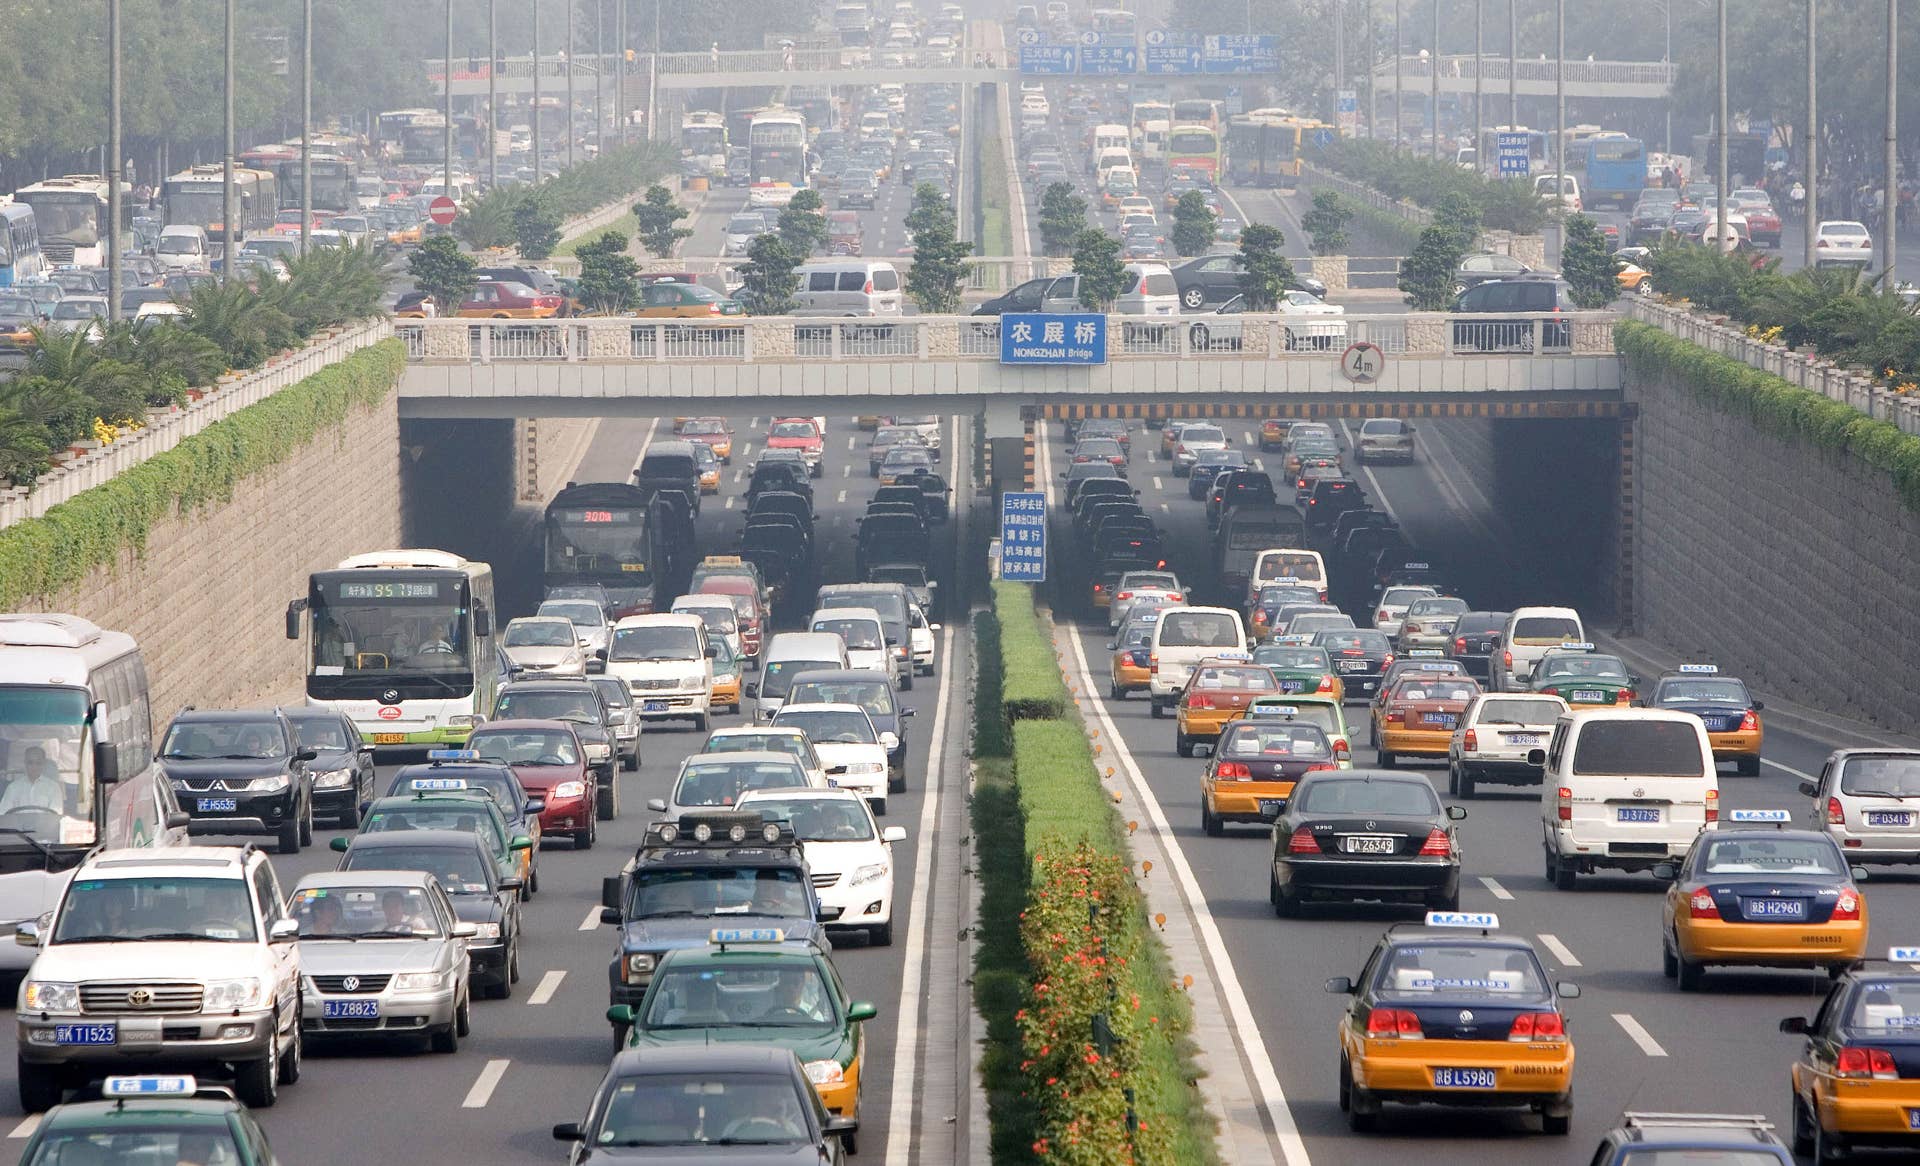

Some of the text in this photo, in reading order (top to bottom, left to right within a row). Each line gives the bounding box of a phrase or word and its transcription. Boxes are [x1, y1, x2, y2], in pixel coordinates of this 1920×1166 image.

[1010, 321, 1097, 345] 农展桥
[1013, 347, 1093, 360] NONGZHAN Bridge
[1353, 353, 1373, 372] 4m
[1005, 498, 1044, 510] 三元桥去往
[1005, 545, 1042, 557] 机场高速
[1003, 561, 1041, 574] 京承高速
[324, 1001, 377, 1016] 京JZ8823
[57, 1025, 114, 1042] 京KT1523
[1436, 1068, 1495, 1087] 京BL5980
